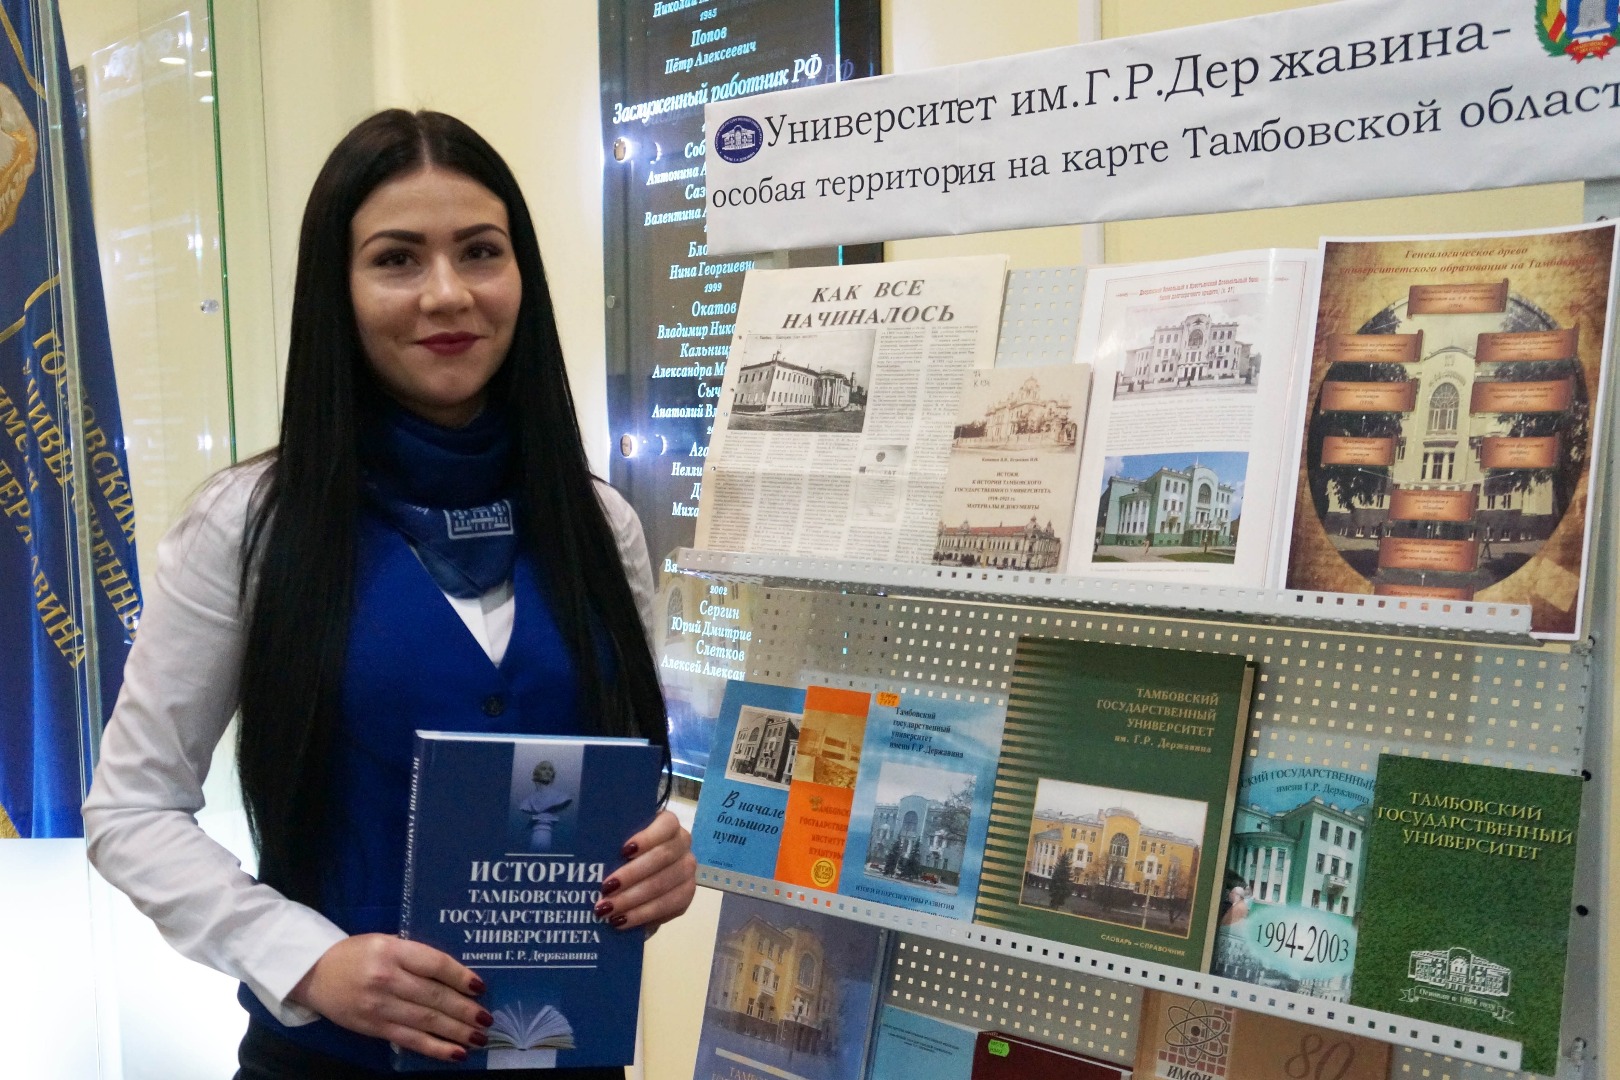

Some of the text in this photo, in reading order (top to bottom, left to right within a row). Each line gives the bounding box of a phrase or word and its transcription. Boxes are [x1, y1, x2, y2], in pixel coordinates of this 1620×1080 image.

[690, 27, 728, 47] Попов
[664, 41, 757, 75] Пётр Алексеевич
[612, 53, 823, 125] Заслуженный работник РФ
[764, 96, 998, 148] Университет
[711, 175, 806, 208] особая
[815, 159, 997, 203] территория
[1007, 153, 1049, 180] на
[1061, 138, 1169, 178] карте
[1181, 100, 1443, 160] Тамбовской
[646, 166, 699, 186] Антонина
[644, 208, 702, 226] Валентина
[669, 264, 697, 280] Нина
[704, 283, 722, 293] 1999
[811, 279, 926, 304] КАК ВСЕ
[691, 301, 737, 317] Окатов
[781, 304, 955, 330] НАЧИНАЛОСЬ
[657, 323, 709, 340] Владимир
[652, 362, 712, 380] Александра
[652, 404, 704, 419] Анатолий
[710, 585, 728, 596] 2002
[699, 600, 740, 620] Сергин
[671, 616, 702, 634] Юрий
[661, 654, 702, 674] Алексей
[1136, 688, 1219, 706] ТАМБОВСКИЙ
[1096, 698, 1217, 722] ГОСУДАРСТВЕННЫЙ
[892, 719, 951, 734] государственный
[1126, 718, 1215, 738] УНИВЕРСИТЕТ
[890, 731, 933, 743] университет
[1157, 737, 1212, 754] Державина
[721, 790, 785, 819] В начале
[1409, 791, 1542, 821] ТАМБОВСКИЙ
[717, 811, 779, 835] большого
[1377, 806, 1574, 845] ГОСУДАРСТВЕННЫЙ
[712, 830, 747, 846] пути
[1402, 828, 1542, 861] УНИВЕРСИТЕТ
[469, 860, 605, 884] ИСТОРИЯ
[468, 888, 603, 904] ТАМБОВСКОГО
[463, 929, 601, 944] УНИВЕРСИТЕТА
[1256, 920, 1349, 964] 1994-2003
[461, 951, 503, 961] имени
[528, 951, 599, 963] Державина
